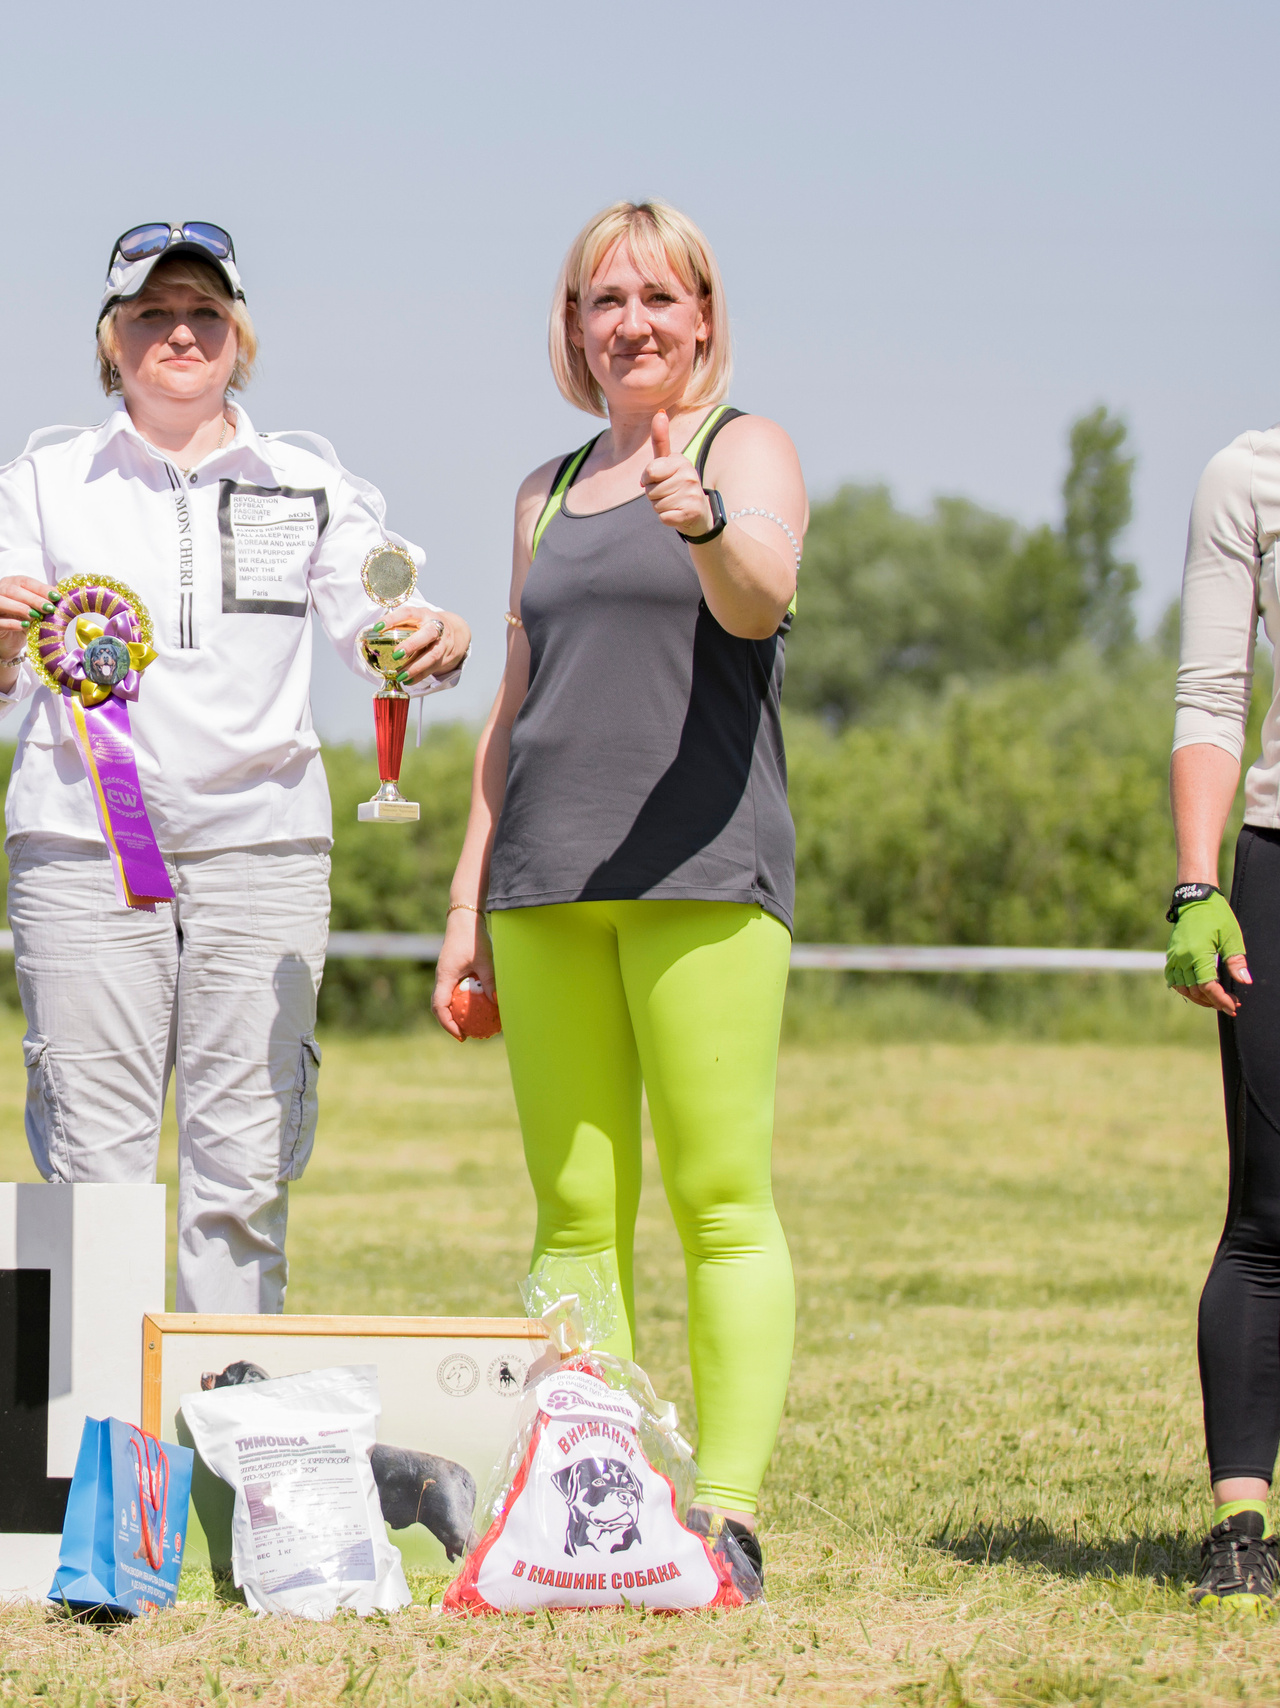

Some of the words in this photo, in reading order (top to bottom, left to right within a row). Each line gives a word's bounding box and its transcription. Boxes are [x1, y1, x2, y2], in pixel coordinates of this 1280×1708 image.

[175, 496, 191, 534] MON
[179, 538, 193, 587] CHERI
[106, 788, 136, 808] CW
[572, 1395, 633, 1418] ZOOLANDER
[235, 1436, 309, 1451] ТИМОШКА
[558, 1422, 636, 1461] ВНИМАНИЕ
[512, 1560, 526, 1578] В
[527, 1564, 607, 1590] МАШИНЕ
[612, 1562, 682, 1589] СОБАКА
